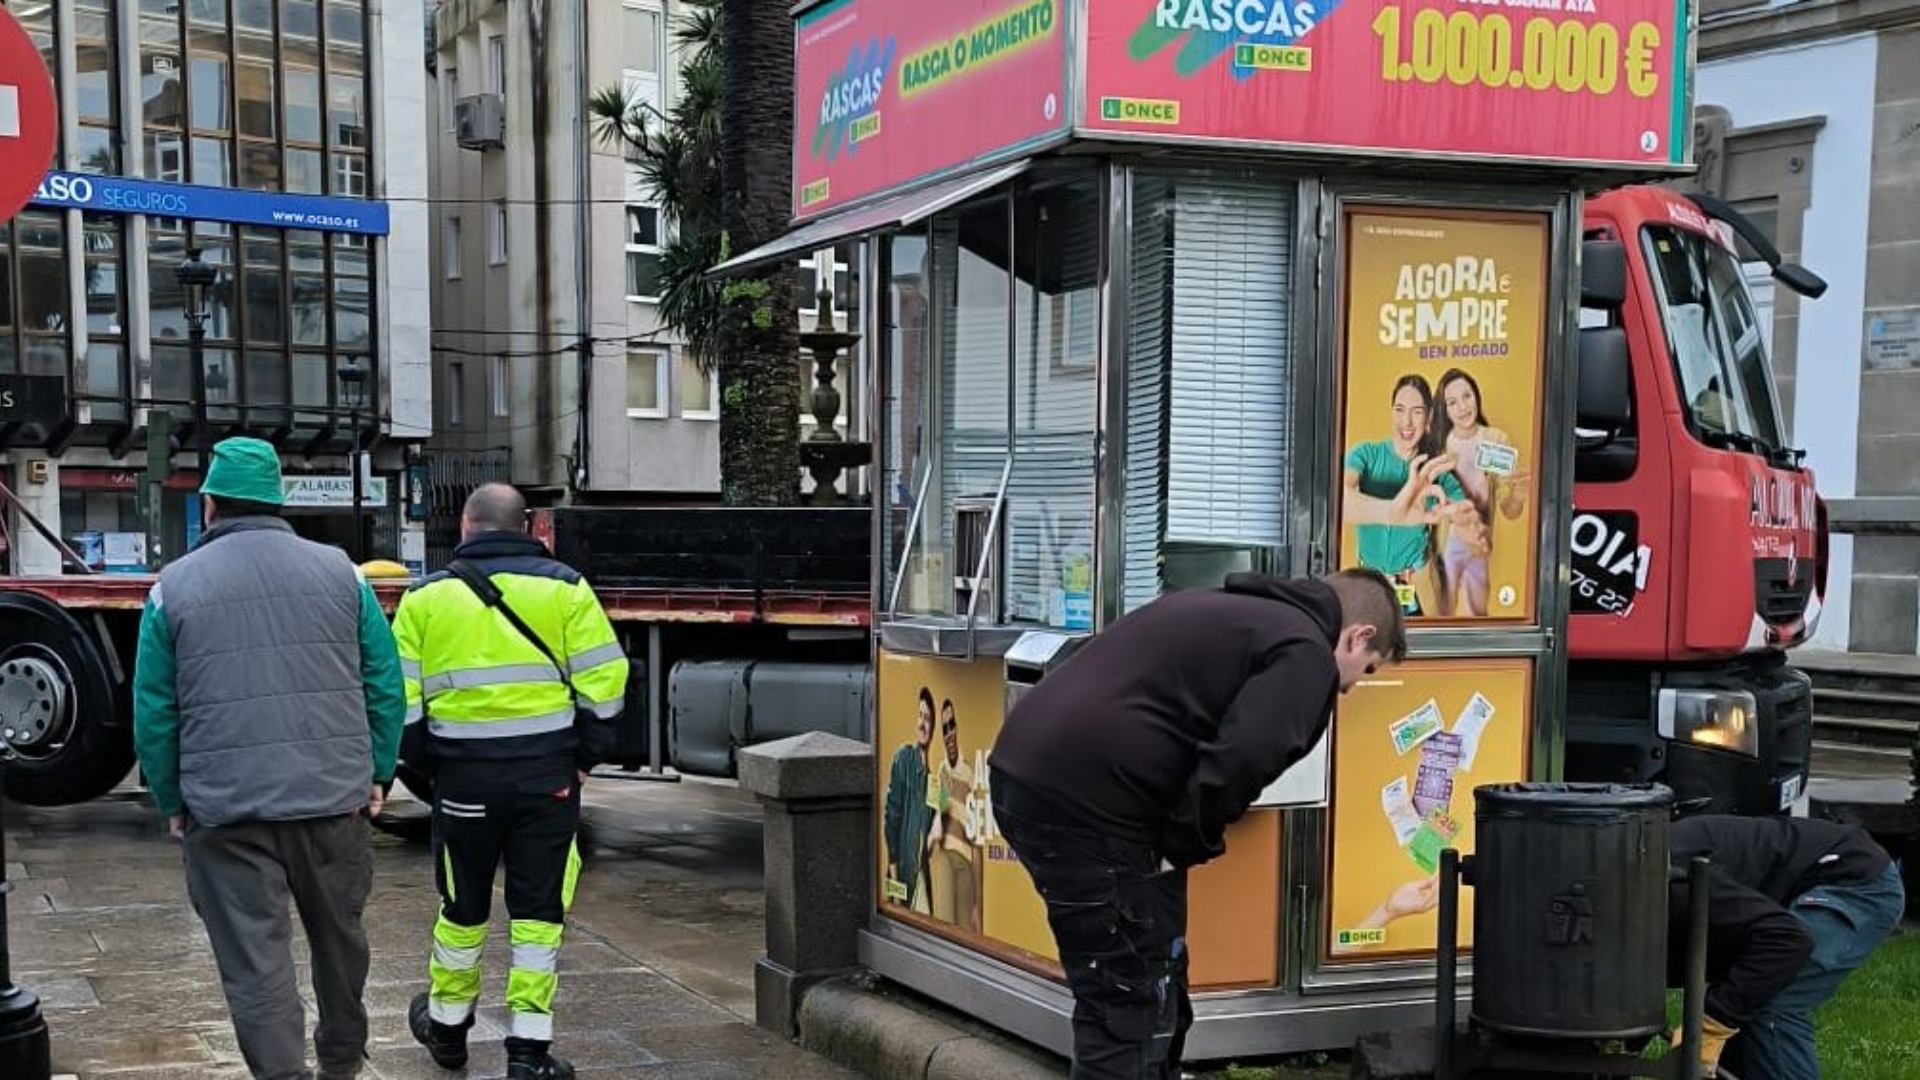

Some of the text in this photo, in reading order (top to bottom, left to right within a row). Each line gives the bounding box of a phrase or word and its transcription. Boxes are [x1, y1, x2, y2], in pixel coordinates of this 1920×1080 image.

[1156, 0, 1316, 38] RASCAS
[903, 1, 1053, 90] RASCA O MOMENTO
[1257, 49, 1307, 67] ONCE
[1372, 6, 1660, 97] 1.000.000 €
[820, 66, 882, 125] RASCAS
[1125, 104, 1173, 120] ONCE
[103, 187, 187, 213] SEGUROS
[272, 210, 359, 229] www.ocaso.es
[1396, 255, 1497, 300] AGORA
[1379, 297, 1508, 349] SEMPRE
[1420, 343, 1508, 360] BEN XOGADO
[300, 479, 352, 491] ALABAST
[1570, 514, 1651, 590] OIA
[1353, 931, 1381, 942] ONCE
